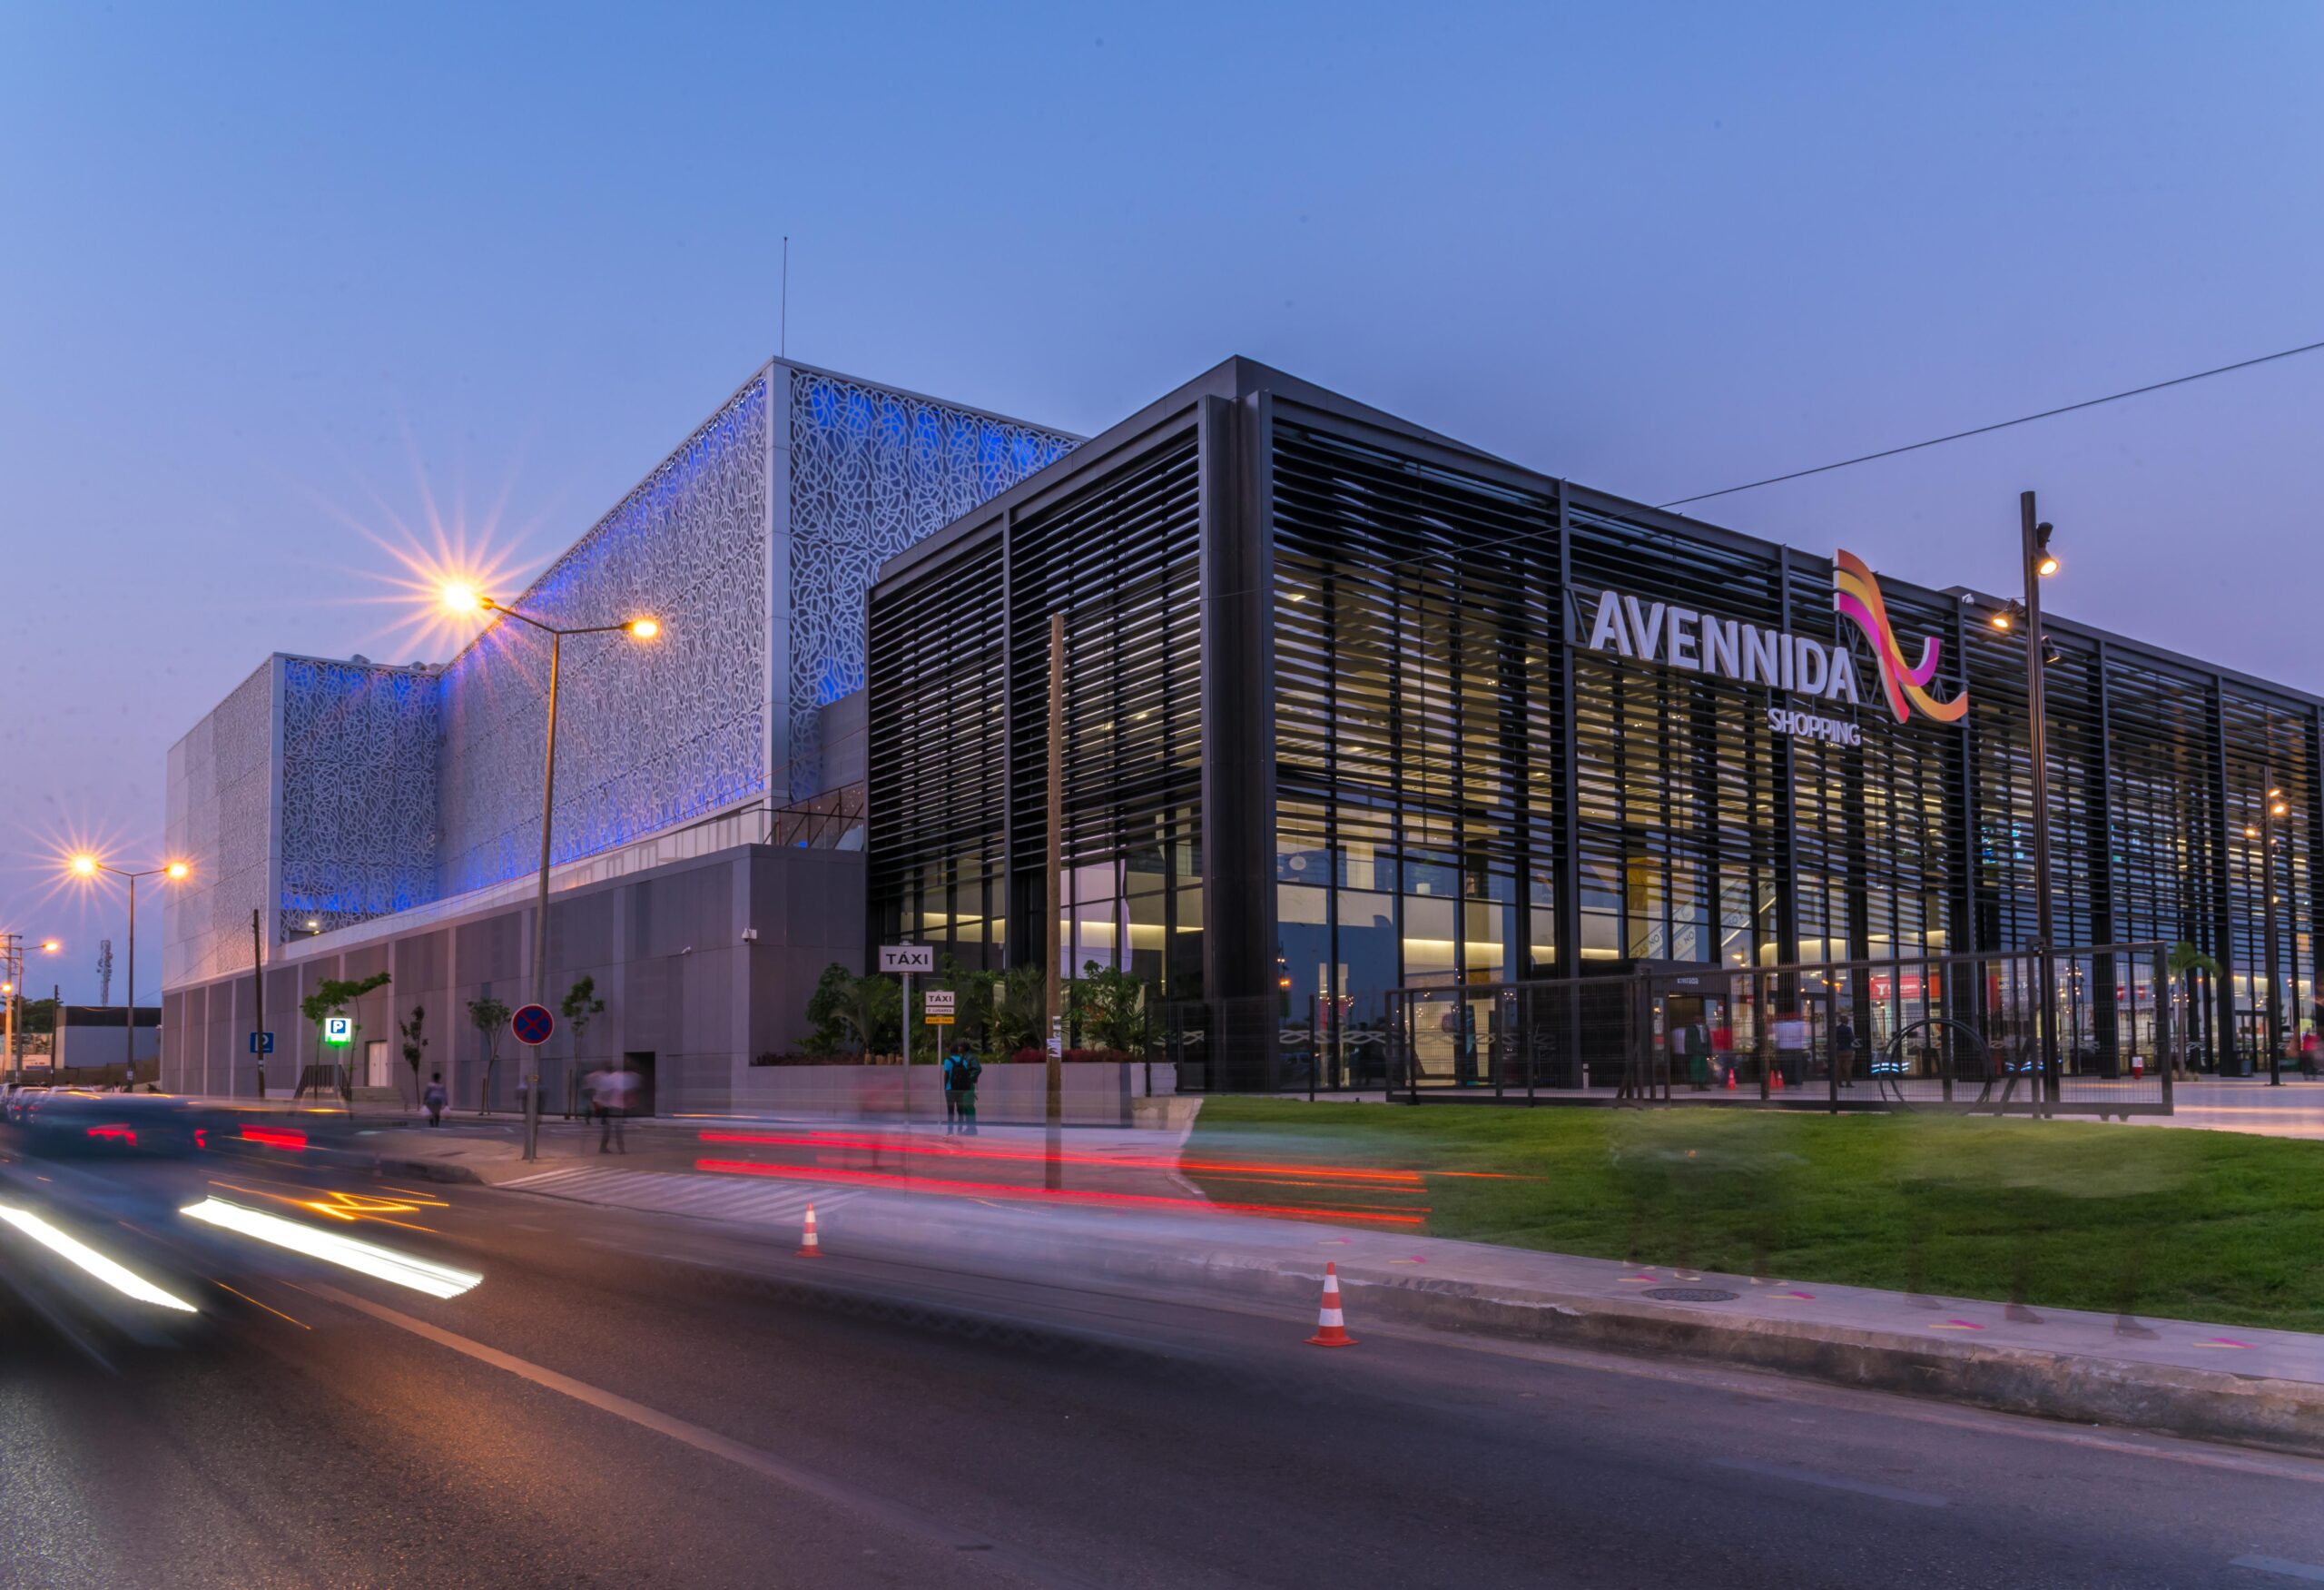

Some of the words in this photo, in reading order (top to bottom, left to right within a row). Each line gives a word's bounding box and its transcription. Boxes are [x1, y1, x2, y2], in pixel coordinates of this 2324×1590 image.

[1590, 591, 1860, 705] AVENNIDA
[1768, 708, 1860, 746] SHOPPING
[886, 952, 928, 964] TÁXI
[332, 1021, 344, 1032] P
